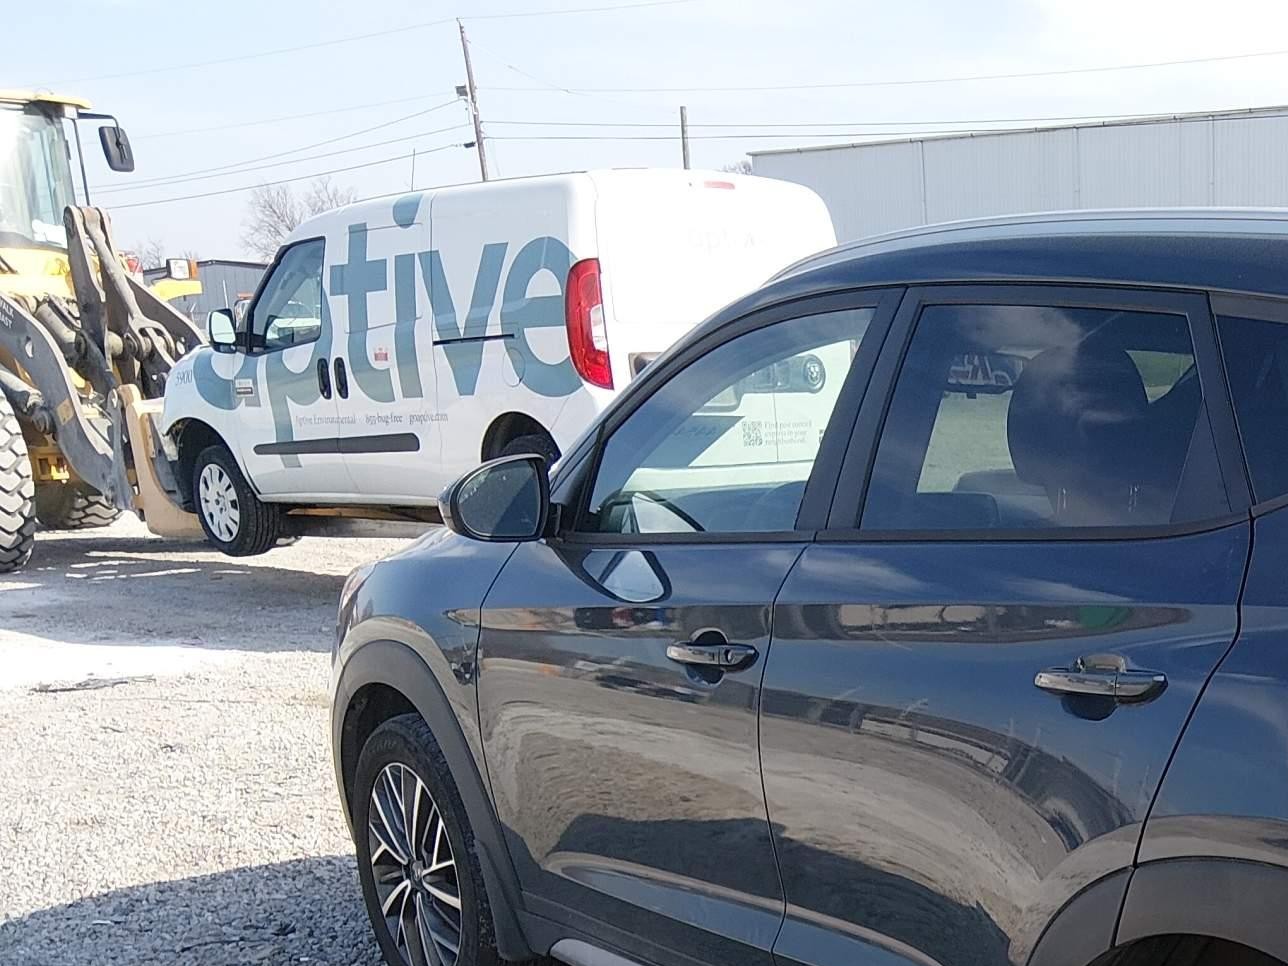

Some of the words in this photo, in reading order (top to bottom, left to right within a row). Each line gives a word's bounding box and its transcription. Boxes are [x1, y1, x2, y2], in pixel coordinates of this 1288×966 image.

[0, 311, 13, 329] AST
[193, 194, 585, 468] aptive
[409, 411, 449, 425] goaptive.com
